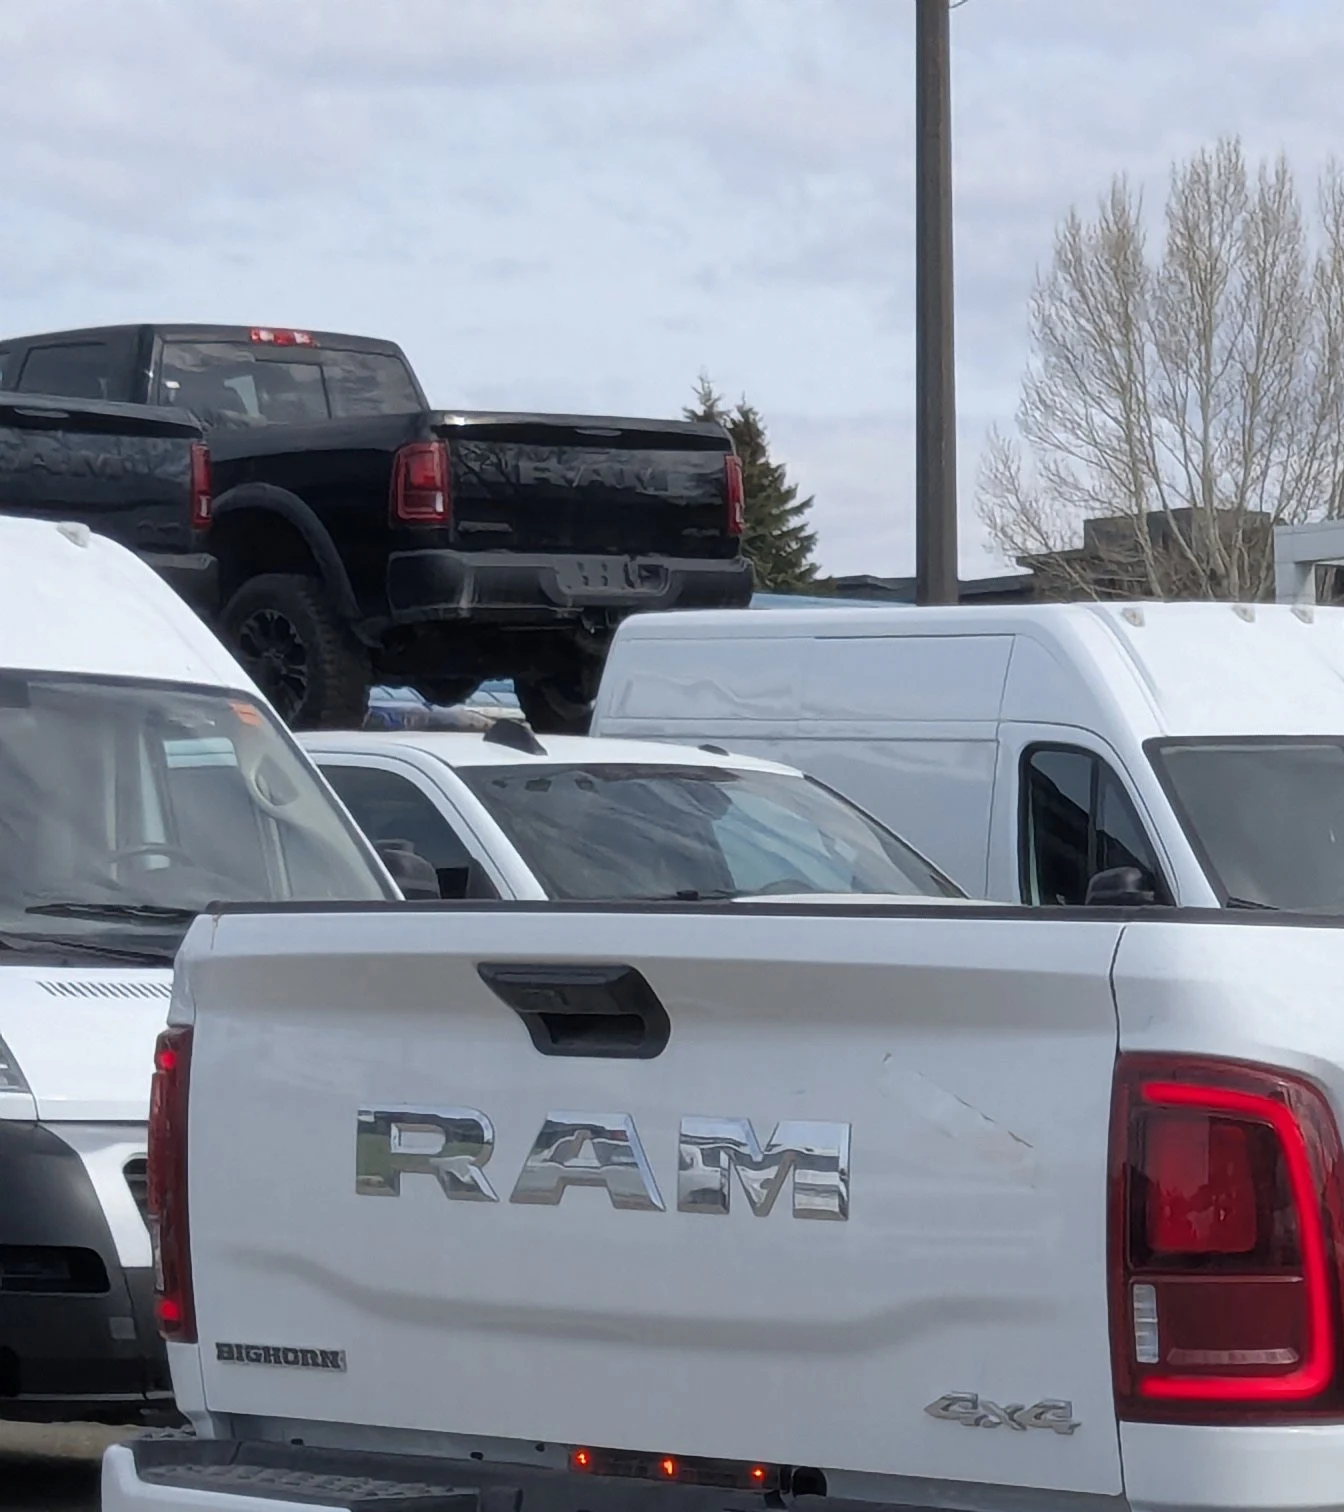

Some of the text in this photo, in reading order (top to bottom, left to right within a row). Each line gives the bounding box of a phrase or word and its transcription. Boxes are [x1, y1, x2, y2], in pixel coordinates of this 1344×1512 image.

[355, 1103, 853, 1221] RAM
[215, 1342, 346, 1371] BIGHORN
[923, 1391, 1082, 1435] 4x4
